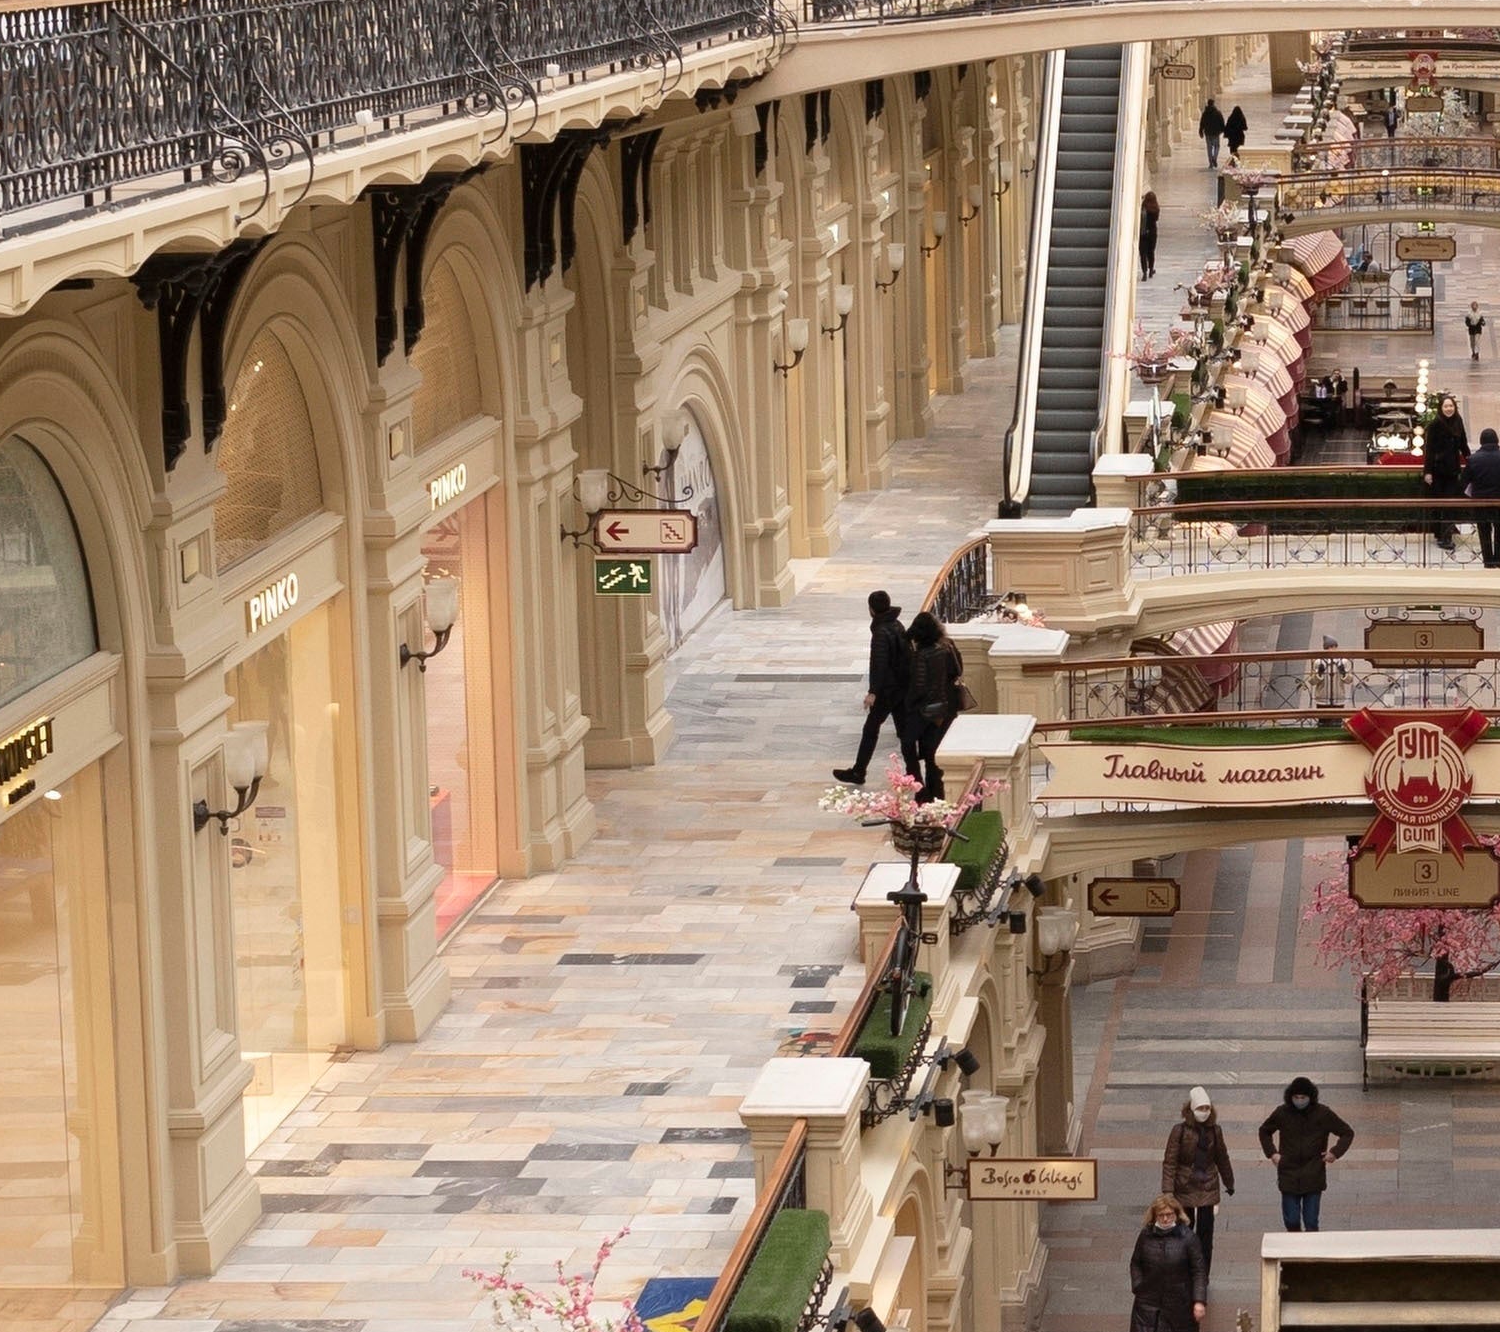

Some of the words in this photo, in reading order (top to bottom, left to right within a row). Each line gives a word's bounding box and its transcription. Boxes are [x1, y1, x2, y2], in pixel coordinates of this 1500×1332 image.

[430, 463, 467, 511] PINKO
[248, 572, 299, 633] PINKO
[1420, 634, 1429, 646] 3
[1398, 727, 1440, 759] ГУМ
[1102, 754, 1207, 784] Главный
[1219, 764, 1325, 785] магазин
[1377, 796, 1417, 824] КРАСНАЯ
[1417, 794, 1461, 824] ПЛОЩАДЬ
[1402, 826, 1437, 843] GUM
[1420, 864, 1432, 879] 3
[1392, 887, 1430, 898] ЛИНИЯ
[1436, 887, 1461, 898] LINE
